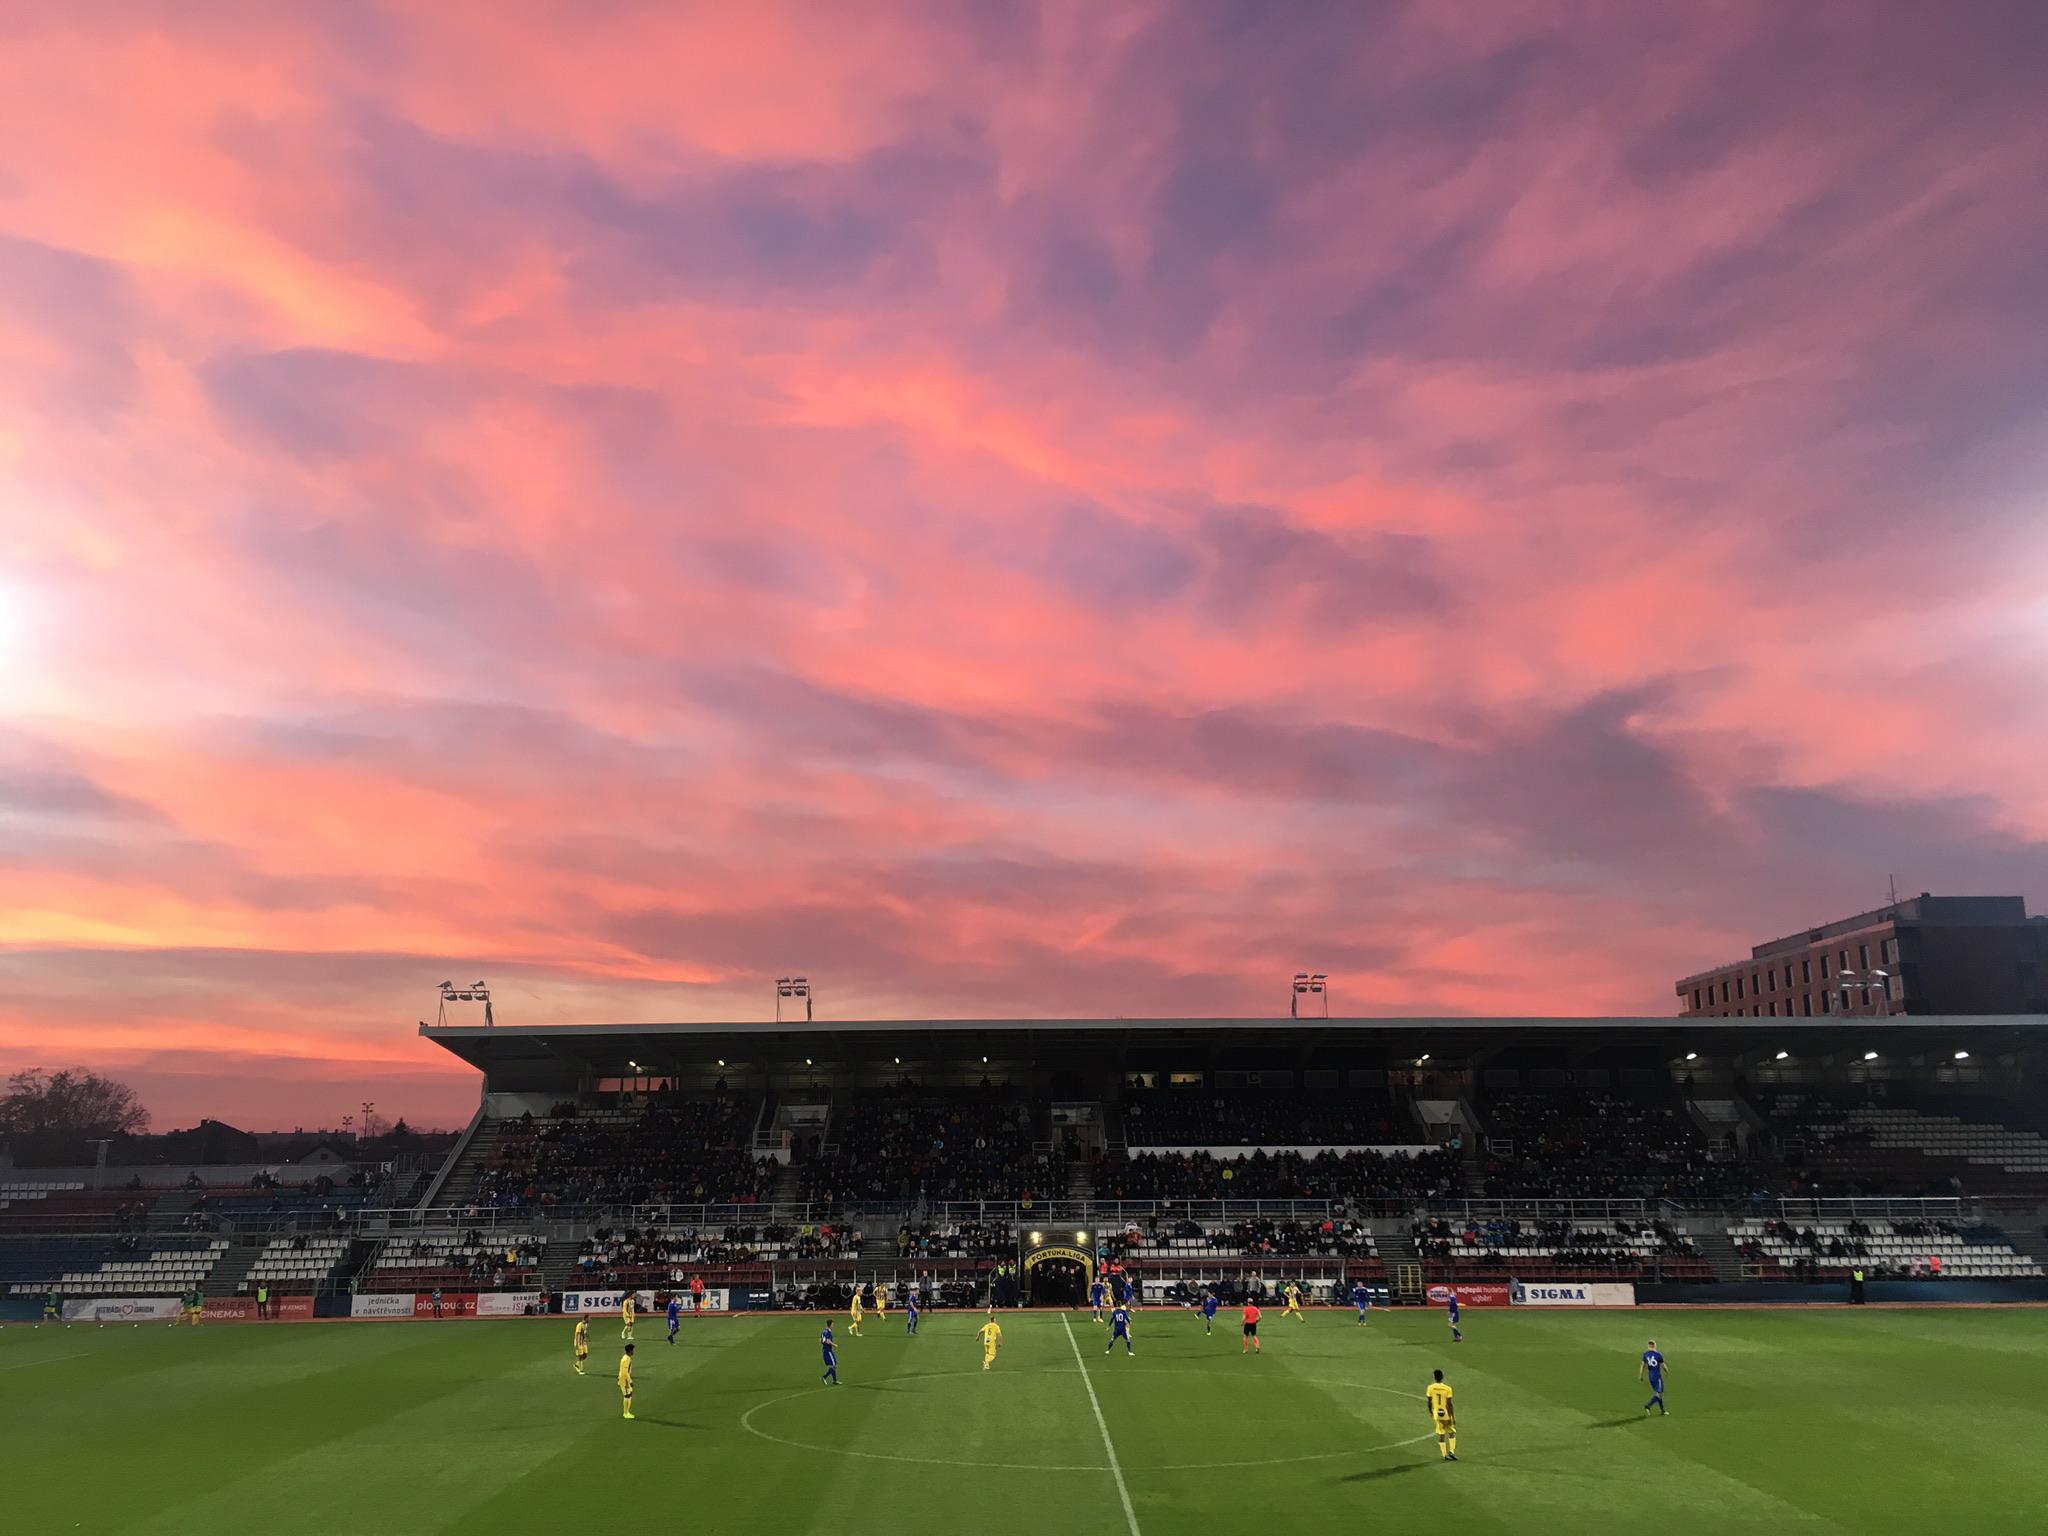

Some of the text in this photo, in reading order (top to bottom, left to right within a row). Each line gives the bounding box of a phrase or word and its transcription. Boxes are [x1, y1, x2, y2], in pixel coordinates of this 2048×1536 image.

[1032, 1250, 1086, 1262] FORTUNA LIGA
[1530, 1289, 1586, 1299] SIGMA
[368, 1297, 399, 1305] jednička
[200, 1310, 246, 1319] CINEMAS
[1116, 1313, 1123, 1321] 10
[1647, 1356, 1658, 1367] 16
